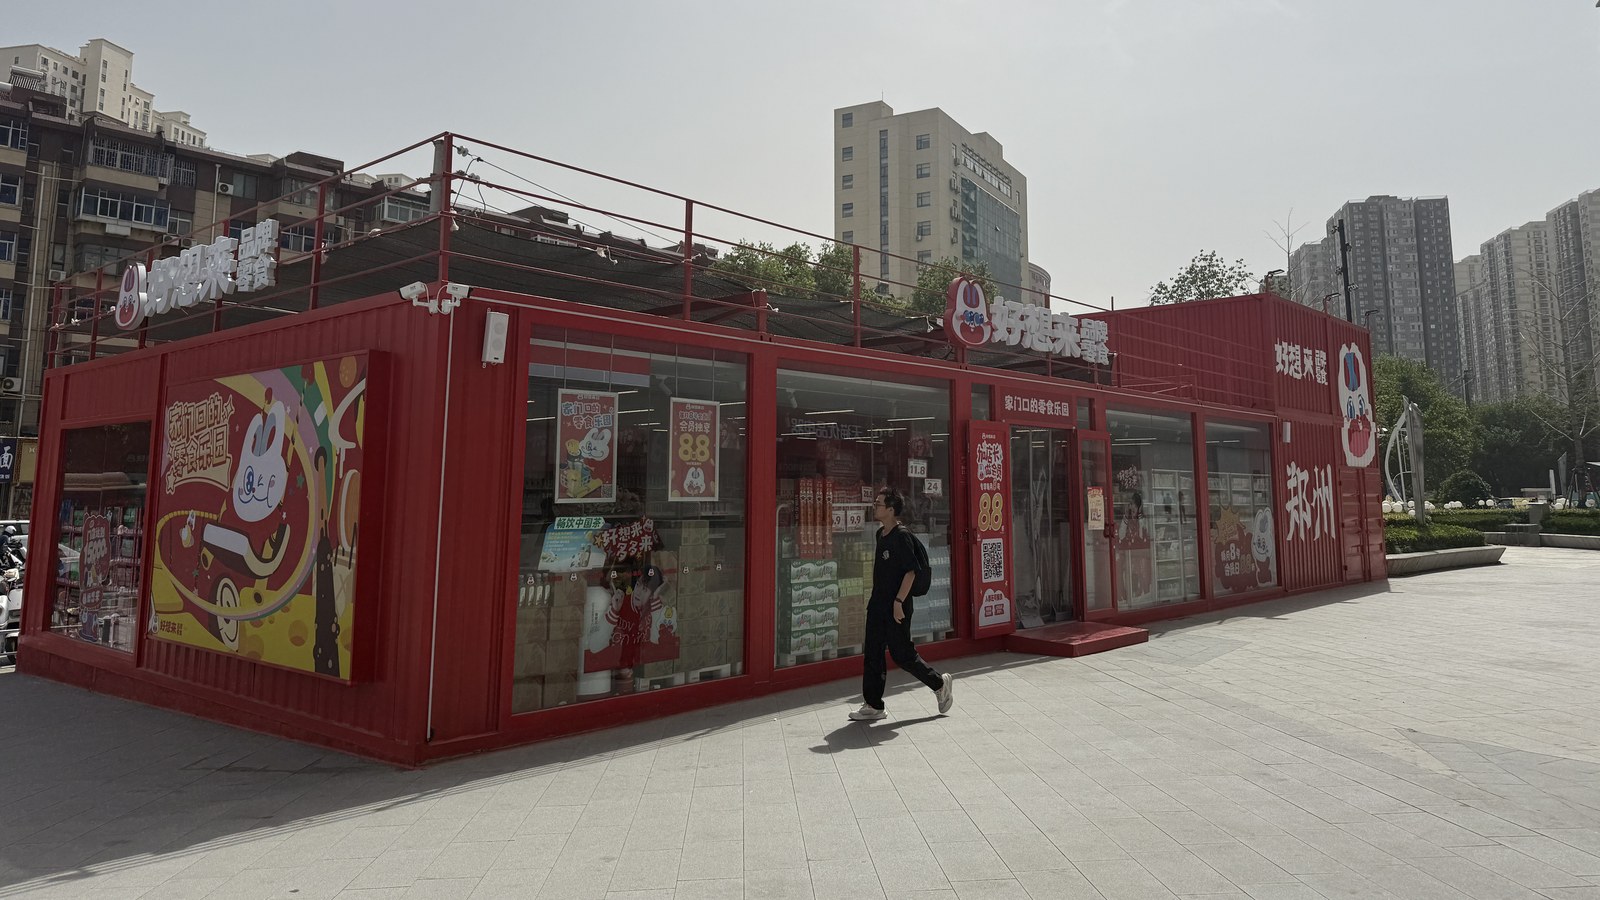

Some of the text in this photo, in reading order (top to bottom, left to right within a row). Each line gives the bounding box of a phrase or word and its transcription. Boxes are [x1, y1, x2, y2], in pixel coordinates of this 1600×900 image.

[989, 296, 1081, 359] 好想来
[1274, 337, 1315, 382] 好想来
[168, 391, 222, 442] 家门口的
[562, 401, 601, 416] 家门口的
[1004, 394, 1070, 417] 家门口的零食乐园
[573, 414, 613, 429] 零食乐园
[679, 420, 711, 434] 会员独享
[168, 424, 228, 478] 零食乐园
[678, 433, 710, 463] 8.8
[909, 465, 926, 476] 11.8
[927, 482, 938, 491] 24
[977, 492, 1003, 532] 8.8
[1285, 461, 1336, 542] 郑州
[556, 517, 602, 529] 畅饮中国茶
[850, 515, 861, 525] 9.9
[603, 521, 644, 548] 好想来
[616, 534, 654, 562] 多多来
